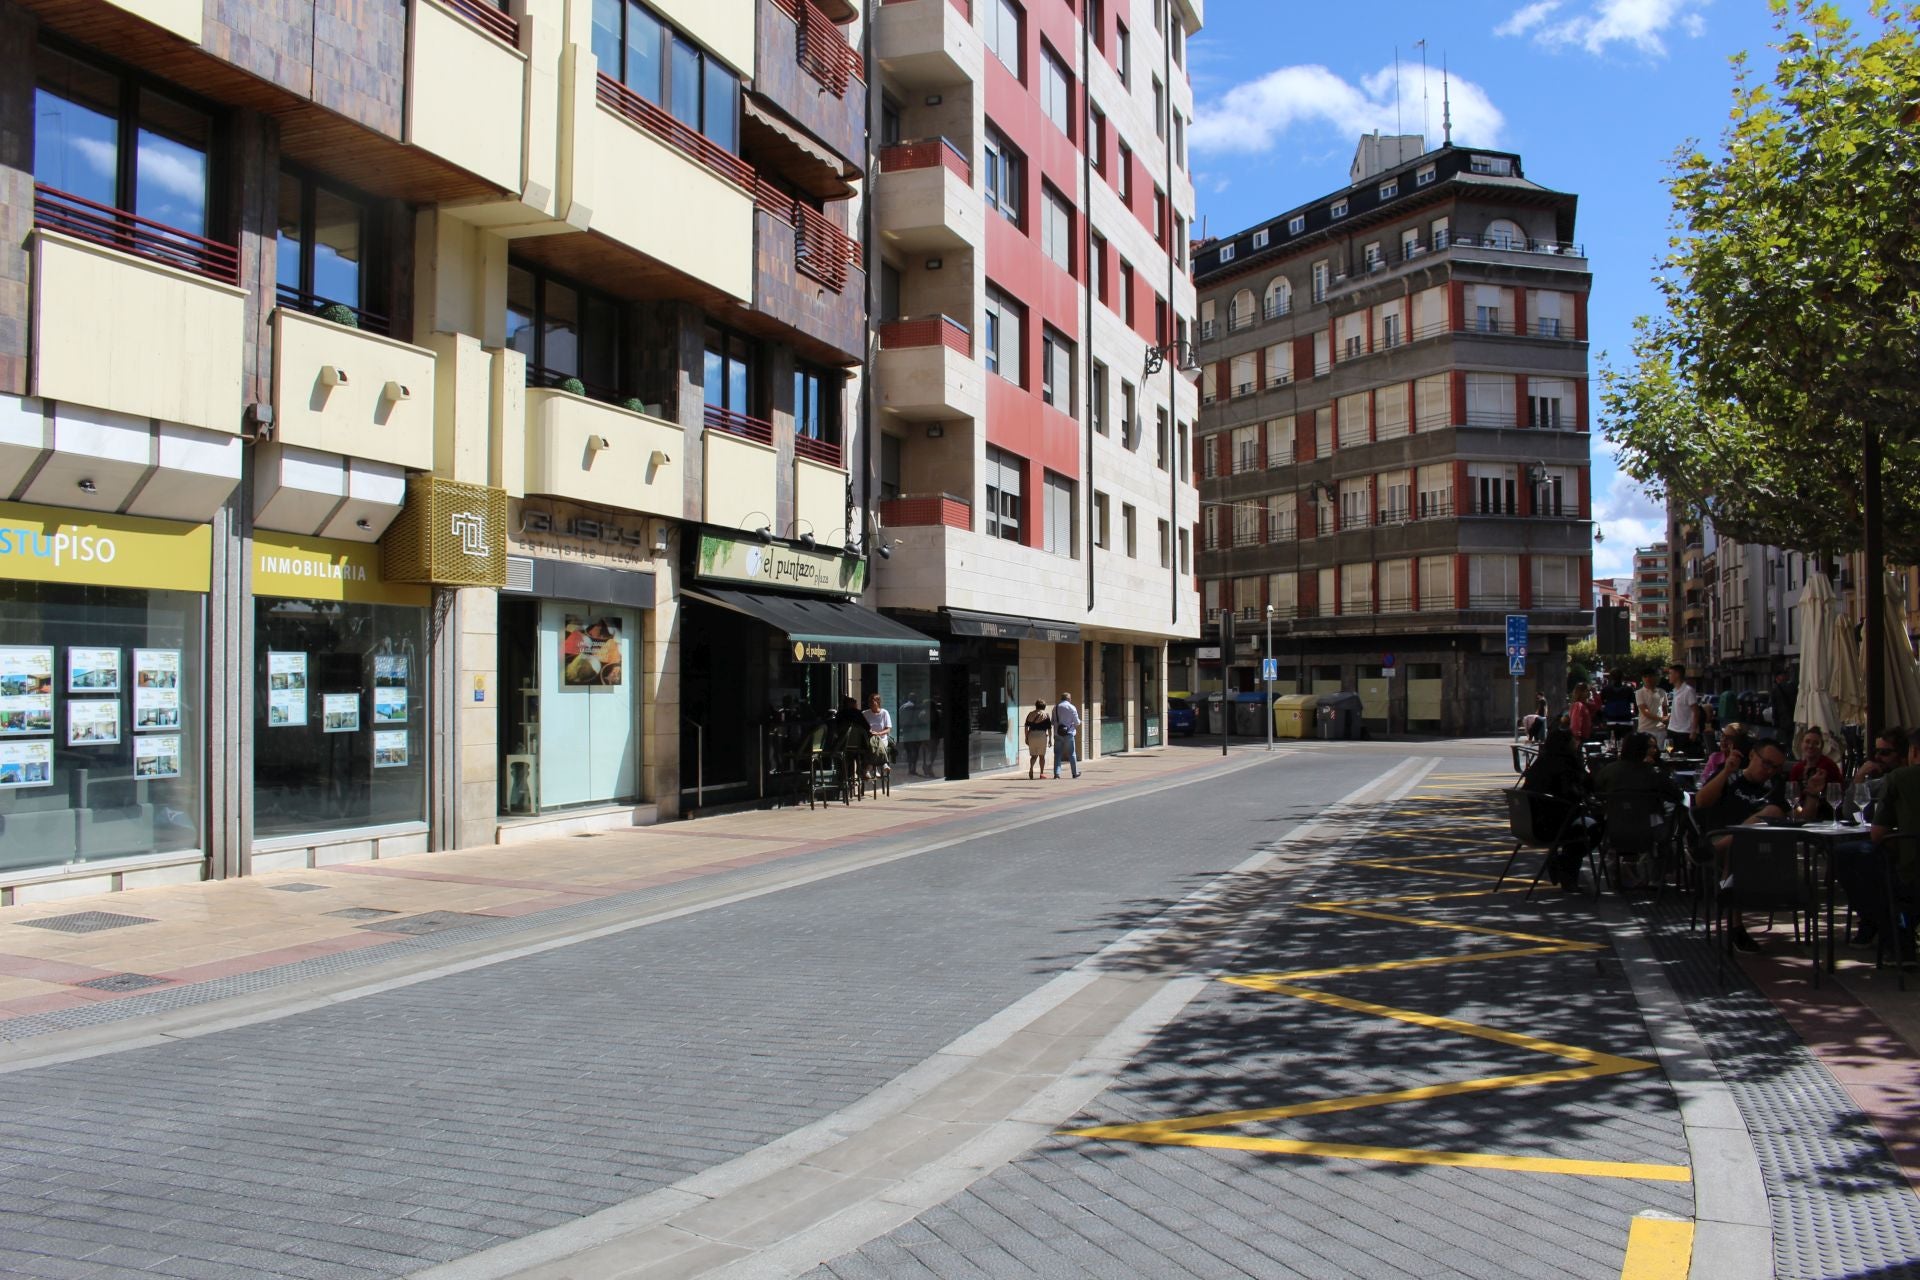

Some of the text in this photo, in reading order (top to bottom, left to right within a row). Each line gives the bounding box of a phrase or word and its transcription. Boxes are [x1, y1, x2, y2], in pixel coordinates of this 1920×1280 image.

[519, 539, 596, 559] ESTILISTAS
[261, 556, 366, 581] INMOBILIARIA
[763, 548, 814, 581] el puntazo
